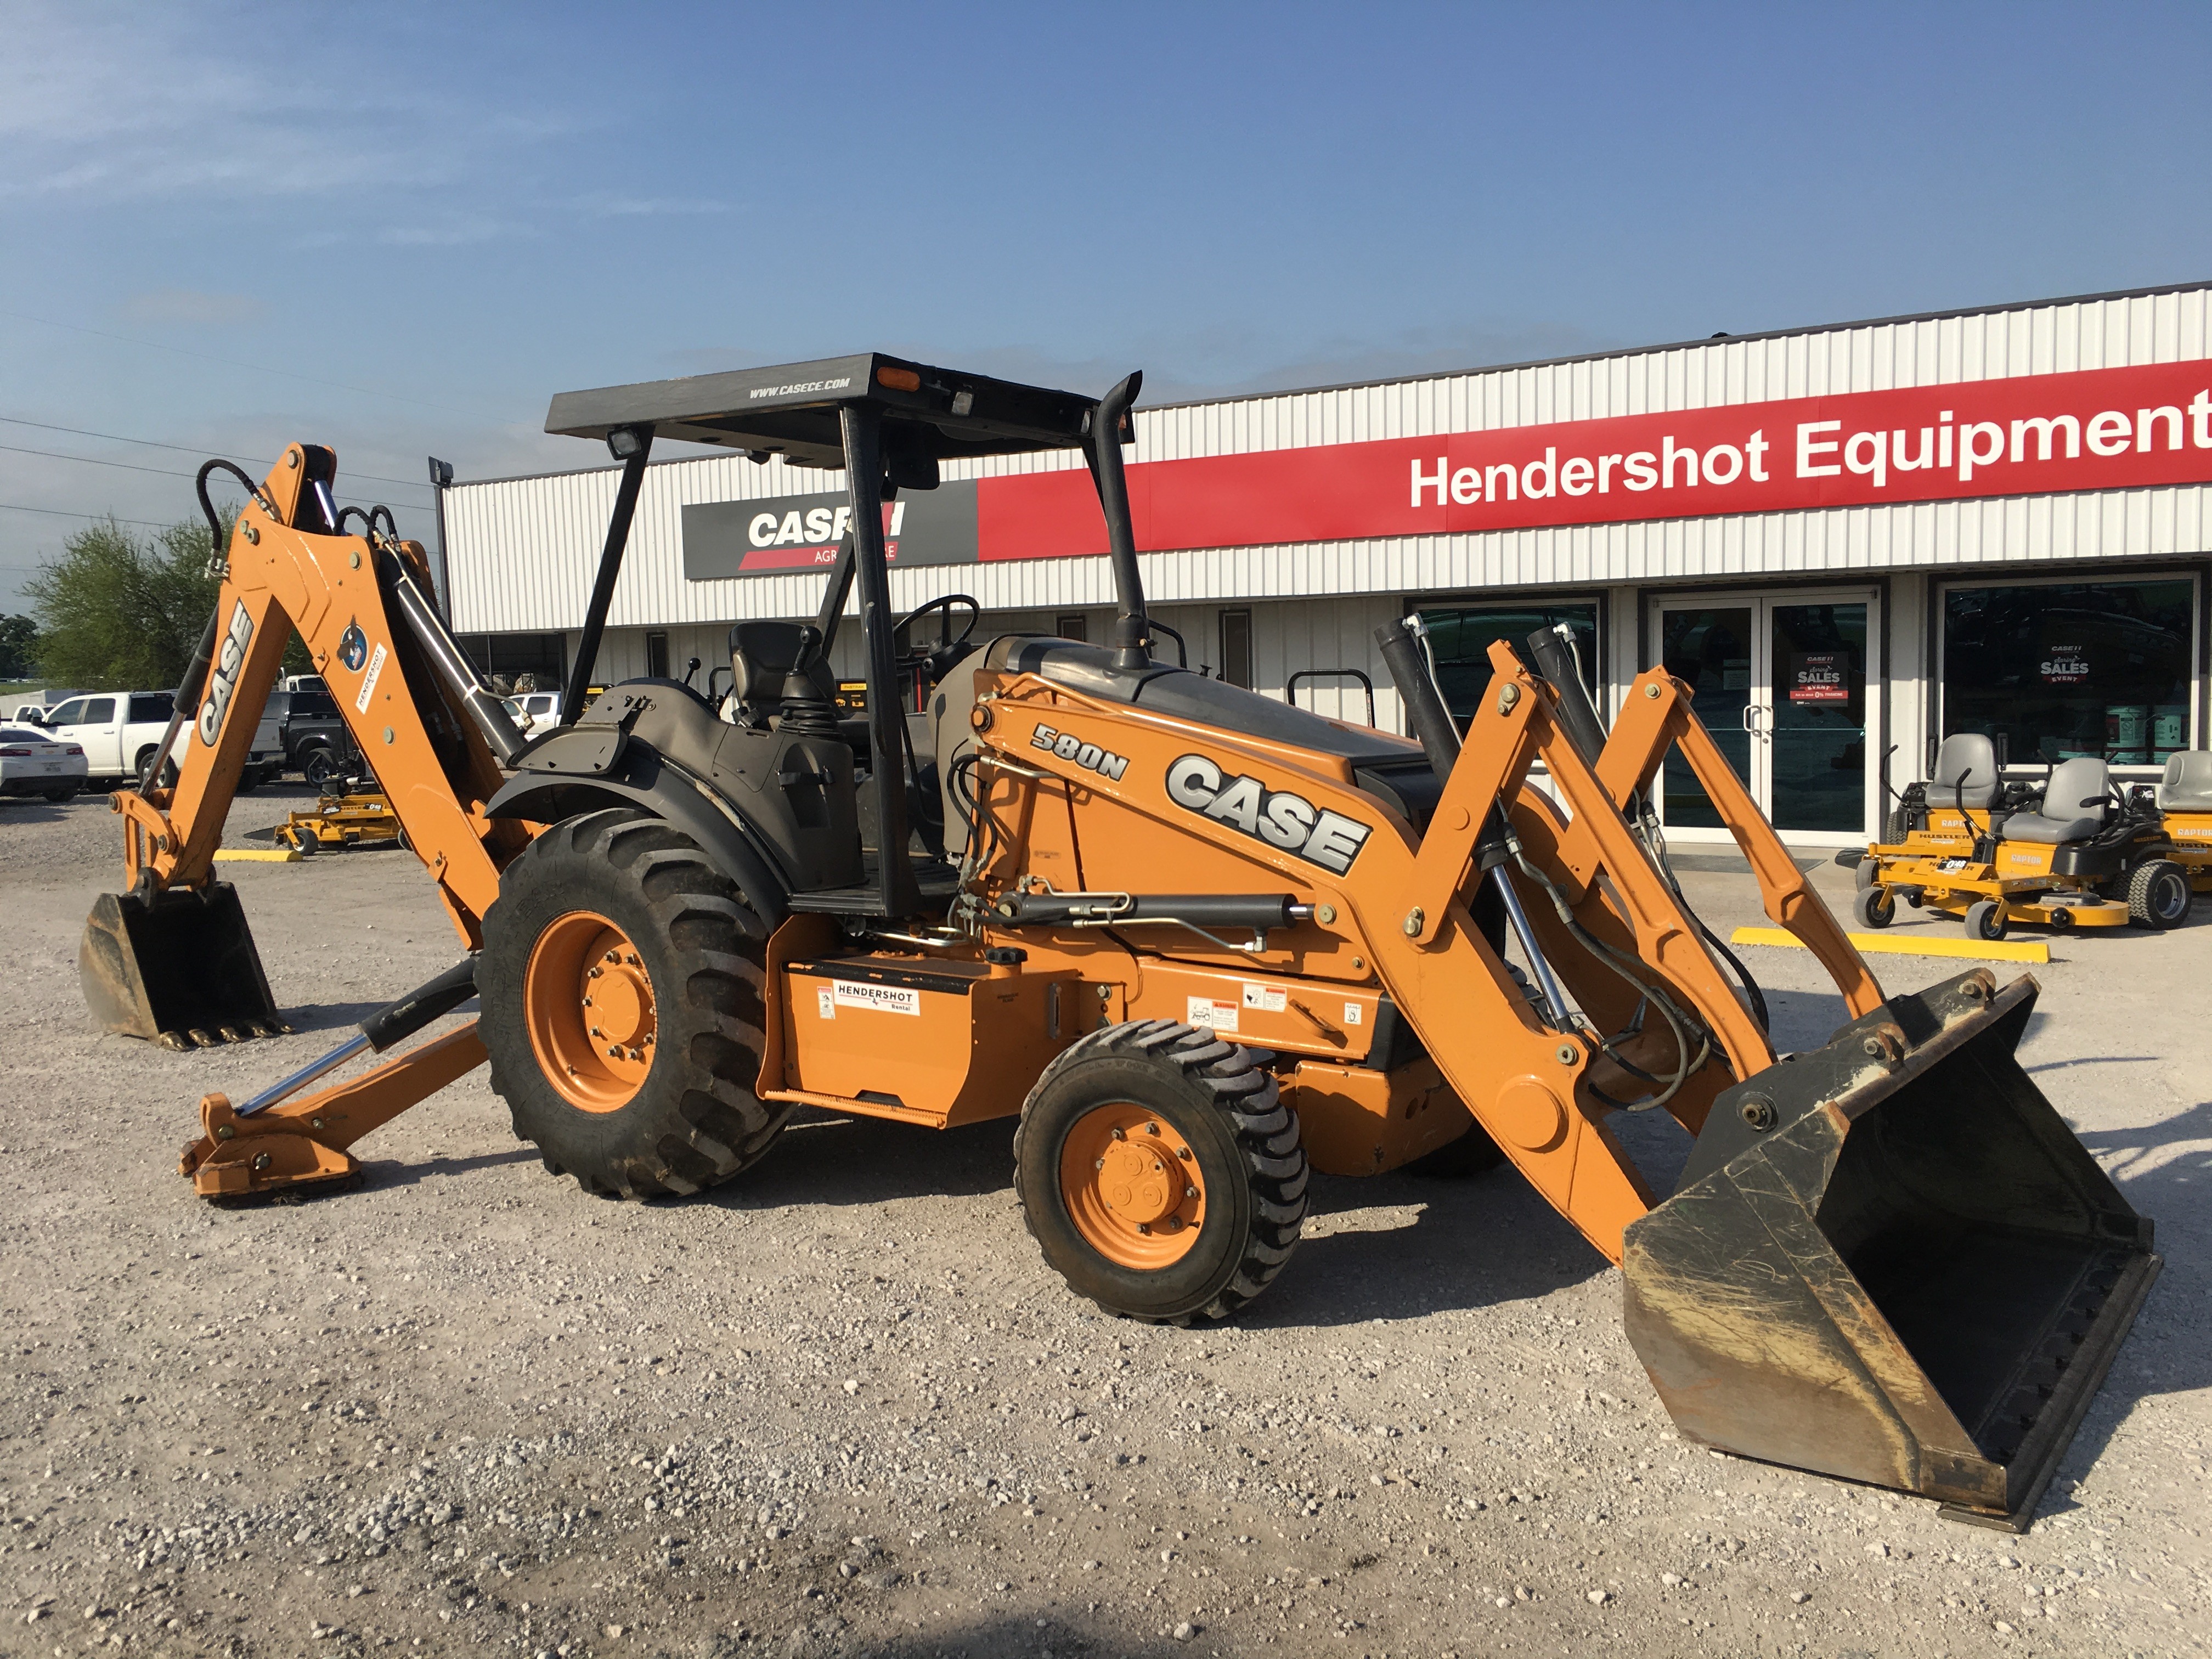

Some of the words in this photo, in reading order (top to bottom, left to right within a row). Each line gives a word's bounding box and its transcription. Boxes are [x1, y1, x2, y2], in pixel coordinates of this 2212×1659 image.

[749, 377, 851, 399] WWW.CASECE.COM
[1410, 428, 1769, 507] Hendershot
[1796, 388, 2212, 487] Equipment
[200, 598, 253, 746] CASE
[358, 648, 382, 707] HENDERSHOT
[1798, 671, 1840, 683] SALES
[2041, 662, 2089, 675] SALES
[1030, 722, 1130, 782] 580N
[1165, 753, 1373, 877] CASE
[2011, 854, 2041, 865] RAPTOR
[838, 984, 912, 1003] HENDERSHOT
